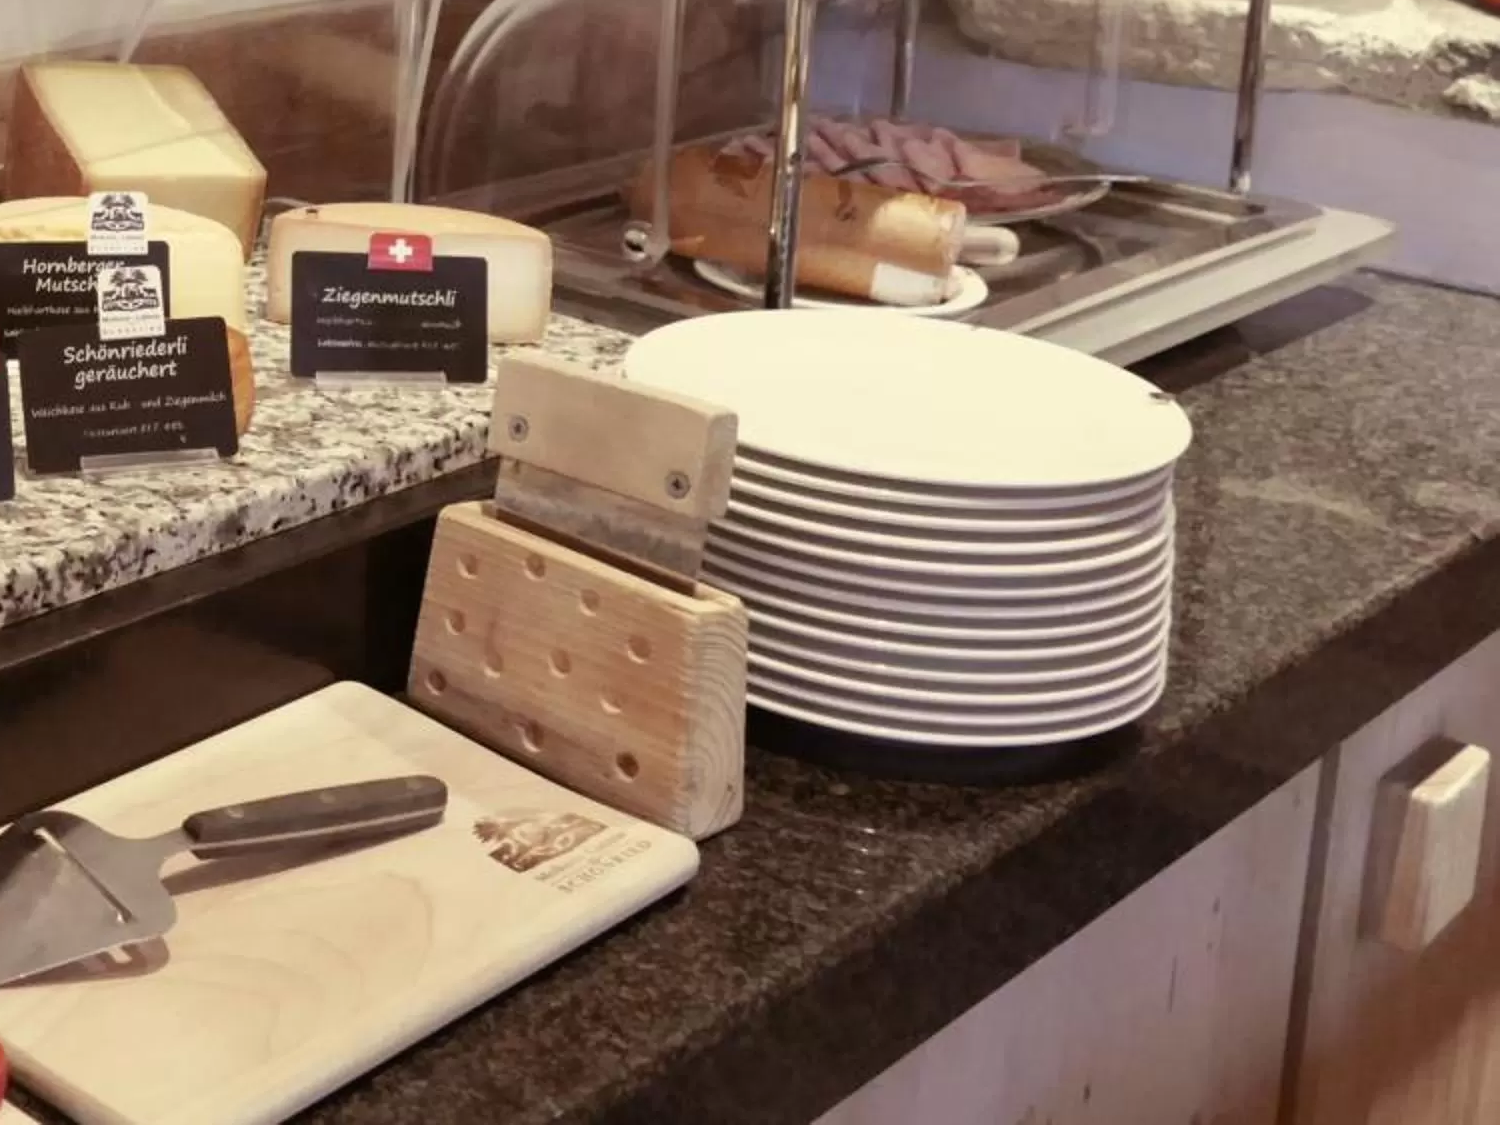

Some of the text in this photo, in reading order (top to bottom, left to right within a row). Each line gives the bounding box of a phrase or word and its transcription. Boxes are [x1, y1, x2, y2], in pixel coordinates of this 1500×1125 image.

[35, 276, 100, 293] Mutsch
[321, 285, 457, 309] Ziegenmutschli
[63, 336, 188, 365] Schönriederli
[74, 360, 178, 390] geräuchert
